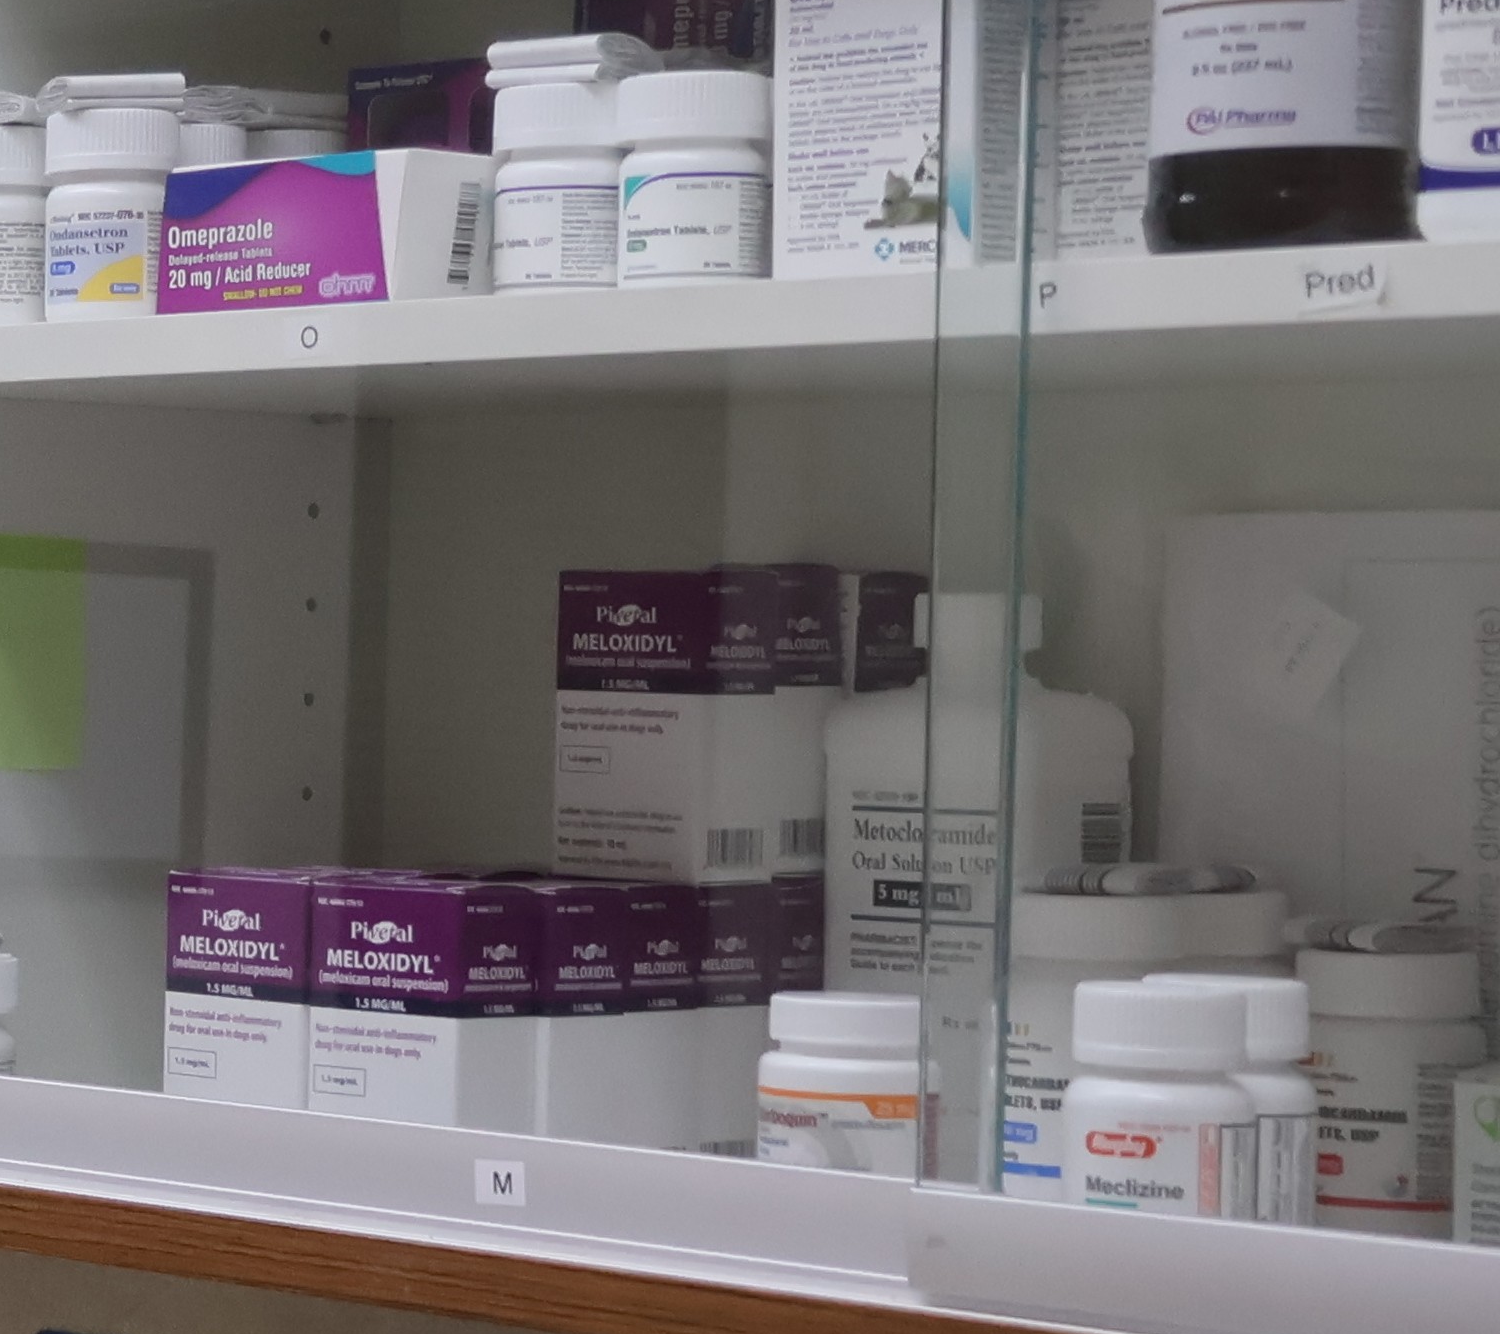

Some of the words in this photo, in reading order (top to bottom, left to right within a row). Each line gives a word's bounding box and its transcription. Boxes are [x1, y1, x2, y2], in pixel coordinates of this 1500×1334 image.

[50, 226, 129, 242] Ondansetron
[167, 217, 274, 251] Omeprazole
[712, 225, 733, 236] USP
[50, 243, 91, 257] Tablets,
[94, 241, 126, 255] USP
[167, 248, 239, 268] Delayed-release
[241, 246, 273, 261] Tablets
[899, 239, 937, 254] MERC
[168, 269, 187, 290] 20
[189, 270, 212, 292] mg
[224, 262, 254, 284] Acid
[255, 261, 312, 282] Reducer
[1304, 264, 1376, 299] Pred
[1039, 282, 1057, 309] P
[300, 325, 318, 349] O
[572, 632, 678, 653] MELOXIDYL
[851, 850, 887, 872] Oral
[877, 882, 887, 899] 5
[891, 885, 920, 904] mg
[179, 934, 280, 962] MELOXIDYL
[172, 956, 221, 974] (meloxicam
[221, 960, 239, 975] oral
[239, 962, 294, 980] suspension)
[326, 947, 434, 975] MELOXIDYL
[205, 982, 220, 994] 1.5
[318, 968, 371, 988] (meloxicam
[371, 973, 391, 989] oral
[391, 976, 449, 995] suspension)
[354, 997, 370, 1009] 1.5
[492, 1171, 513, 1195] M
[1085, 1175, 1185, 1200] Meclizine
